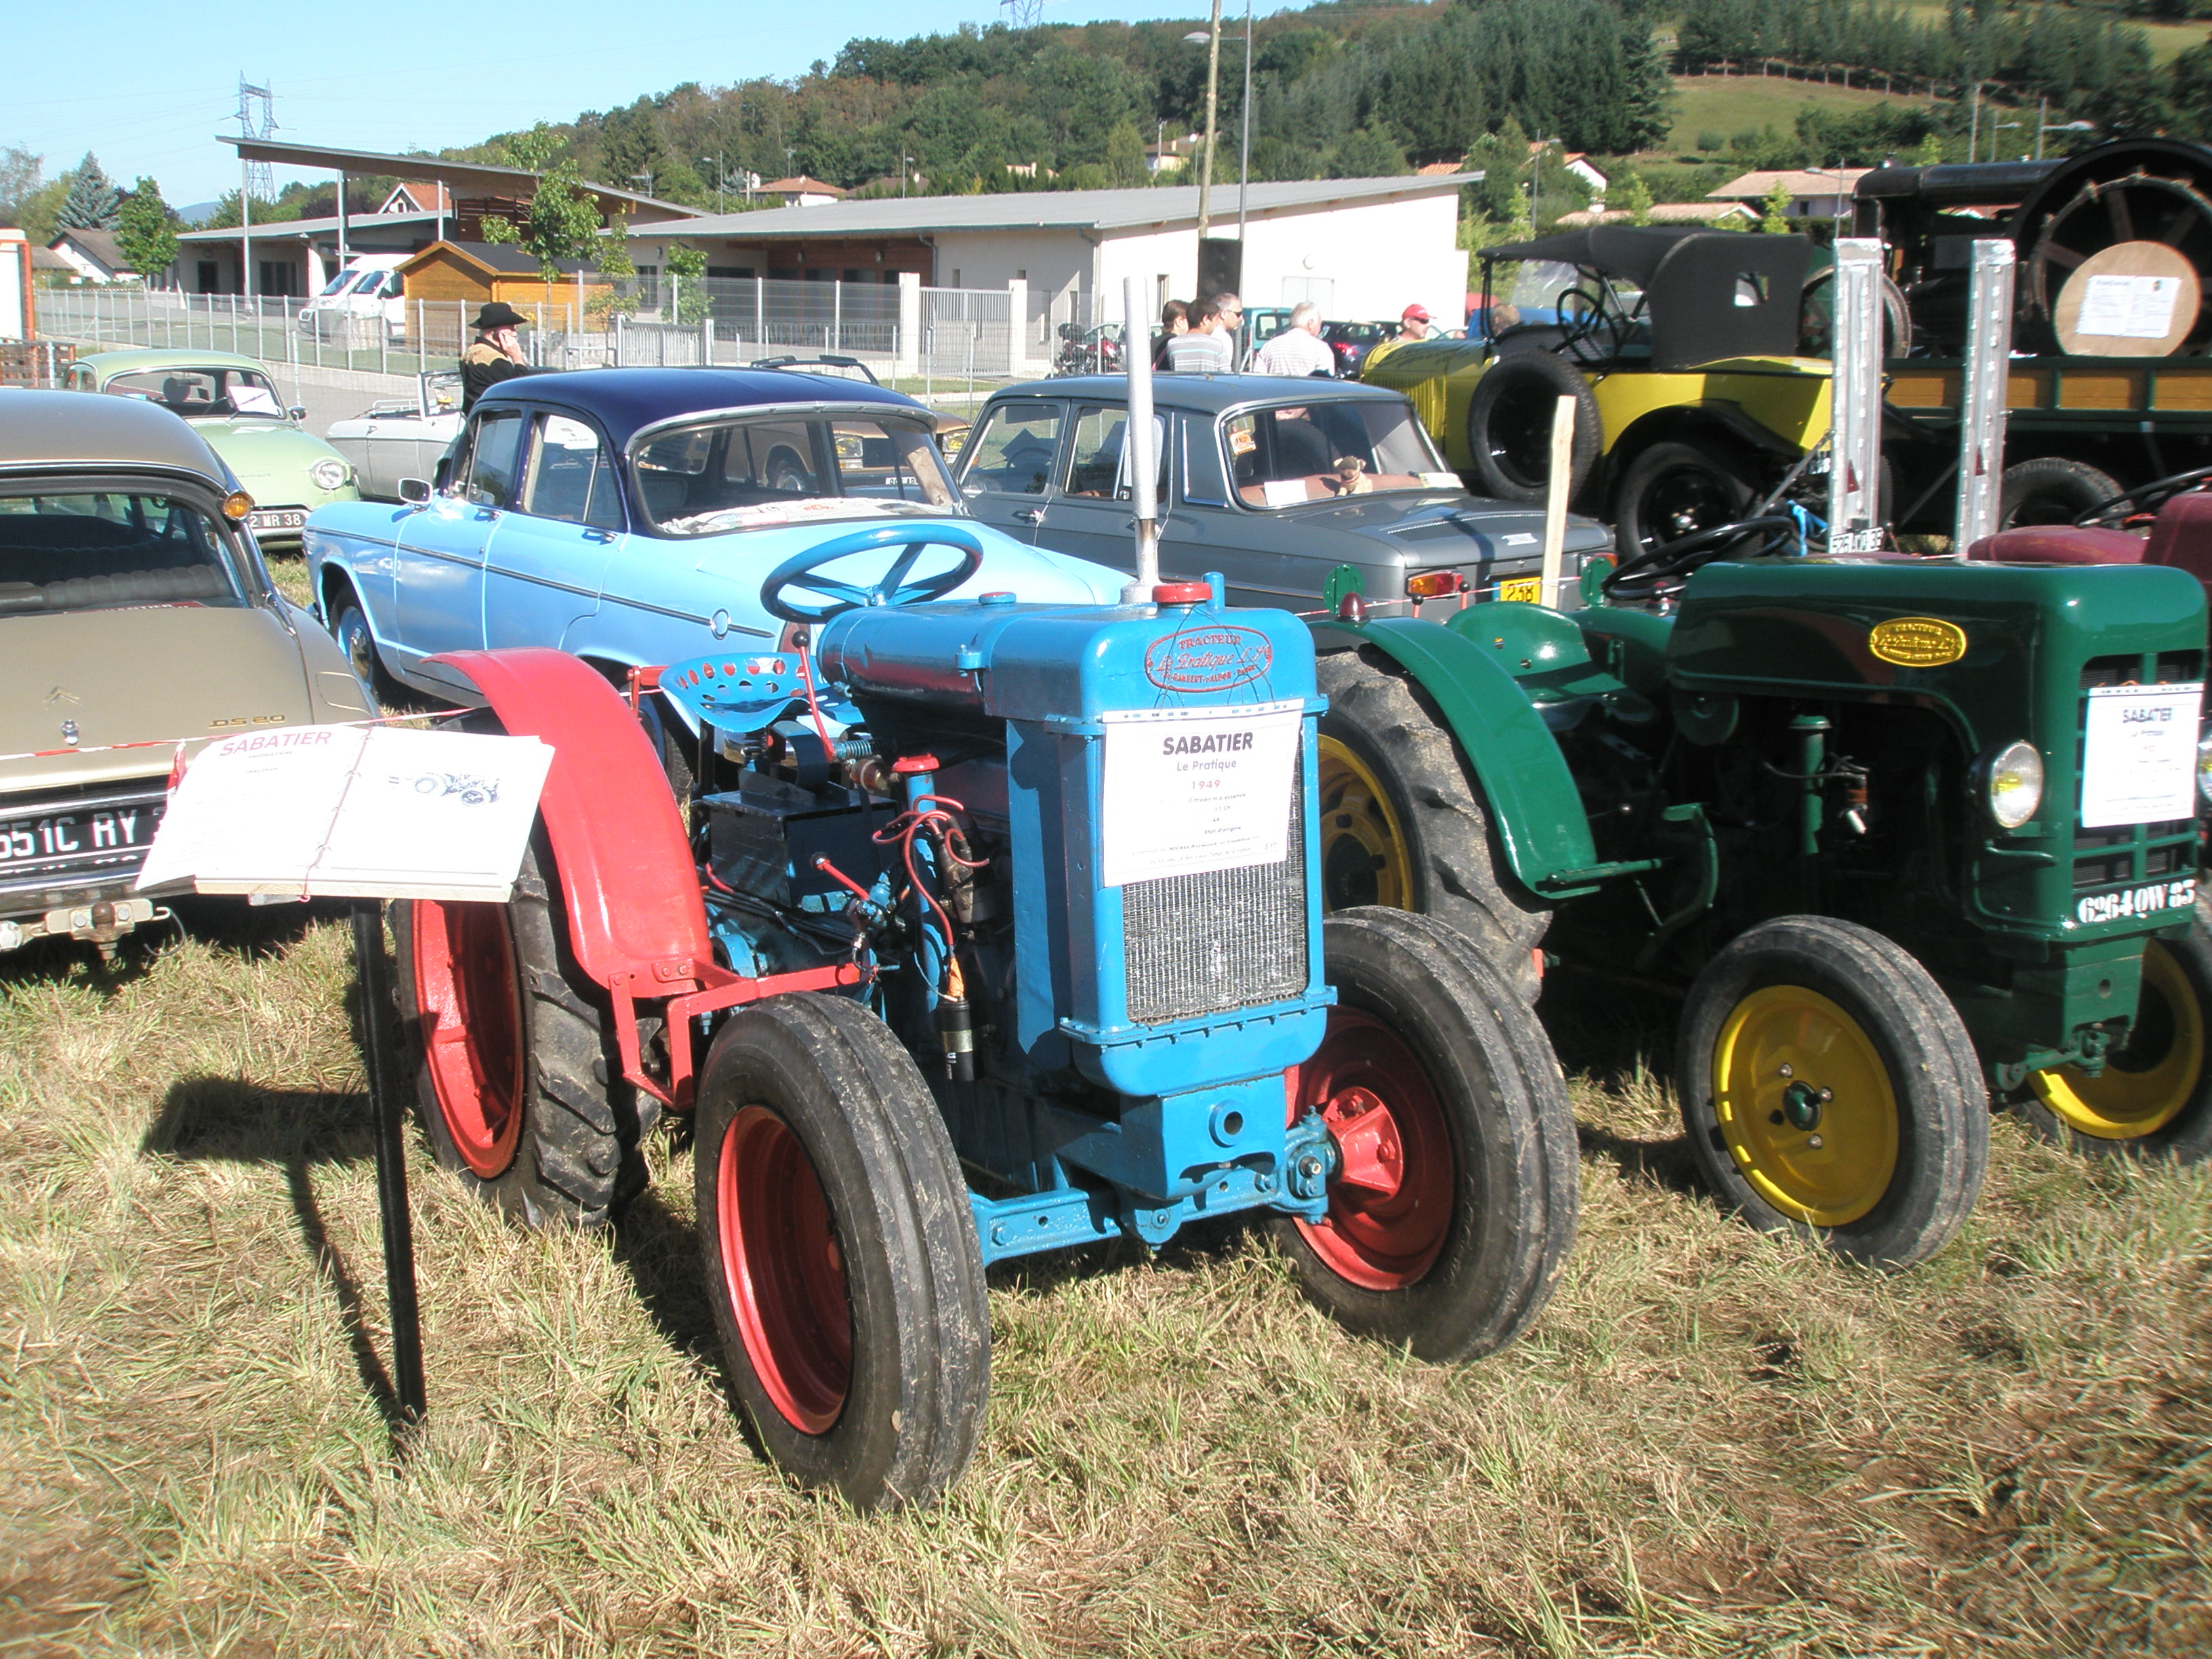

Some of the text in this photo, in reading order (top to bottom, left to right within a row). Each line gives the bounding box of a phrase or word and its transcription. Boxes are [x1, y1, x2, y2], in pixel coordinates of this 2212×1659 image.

[263, 514, 280, 527] MR
[284, 514, 302, 526] 38
[1179, 634, 1242, 651] TRACTEUR
[1174, 652, 1235, 671] Pratique
[208, 714, 286, 729] DS 20
[219, 731, 333, 757] SABATIER
[1162, 732, 1254, 756] SABATIER
[1176, 759, 1237, 772] Le Pratique
[1191, 779, 1221, 790] 1949
[92, 810, 138, 847] RY
[2077, 890, 2133, 924] 6264
